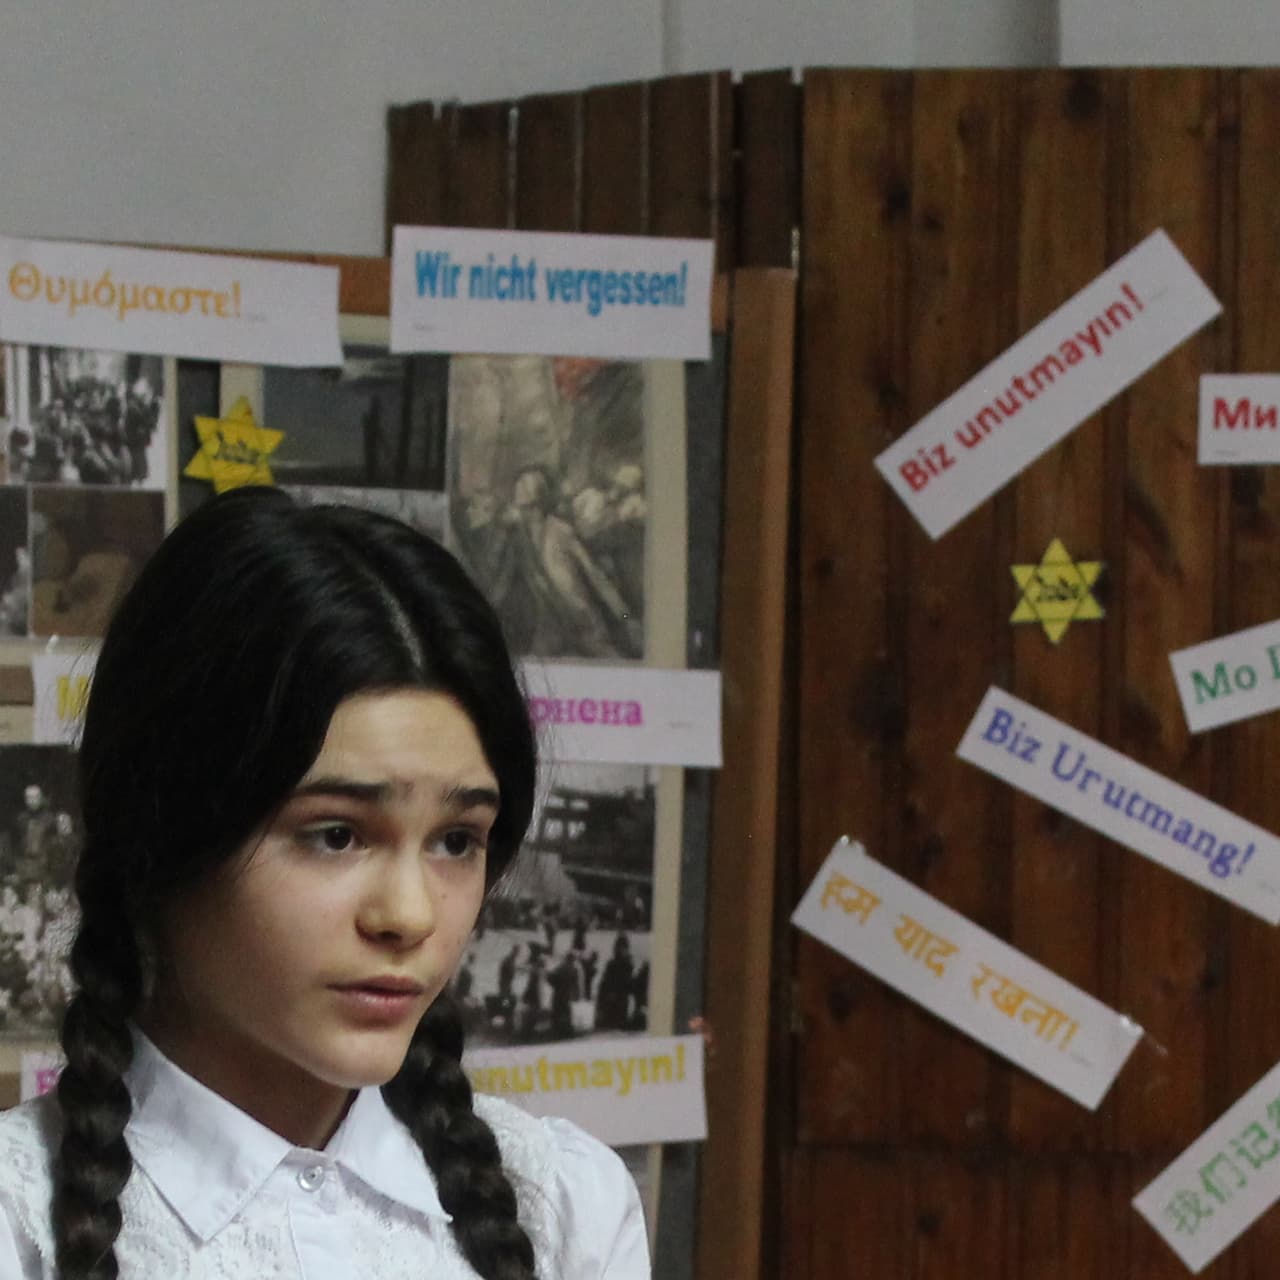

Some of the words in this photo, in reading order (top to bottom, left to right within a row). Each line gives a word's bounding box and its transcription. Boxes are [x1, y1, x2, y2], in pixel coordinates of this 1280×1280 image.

[8, 262, 242, 320] Θυμόμαστε!
[416, 252, 462, 298] Wir
[469, 256, 538, 301] nicht
[544, 263, 688, 317] vergessen!
[1213, 398, 1278, 430] Ми
[899, 441, 956, 494] Biz
[1191, 662, 1256, 704] Мо
[984, 707, 1042, 763] Biz
[893, 914, 960, 978] याद
